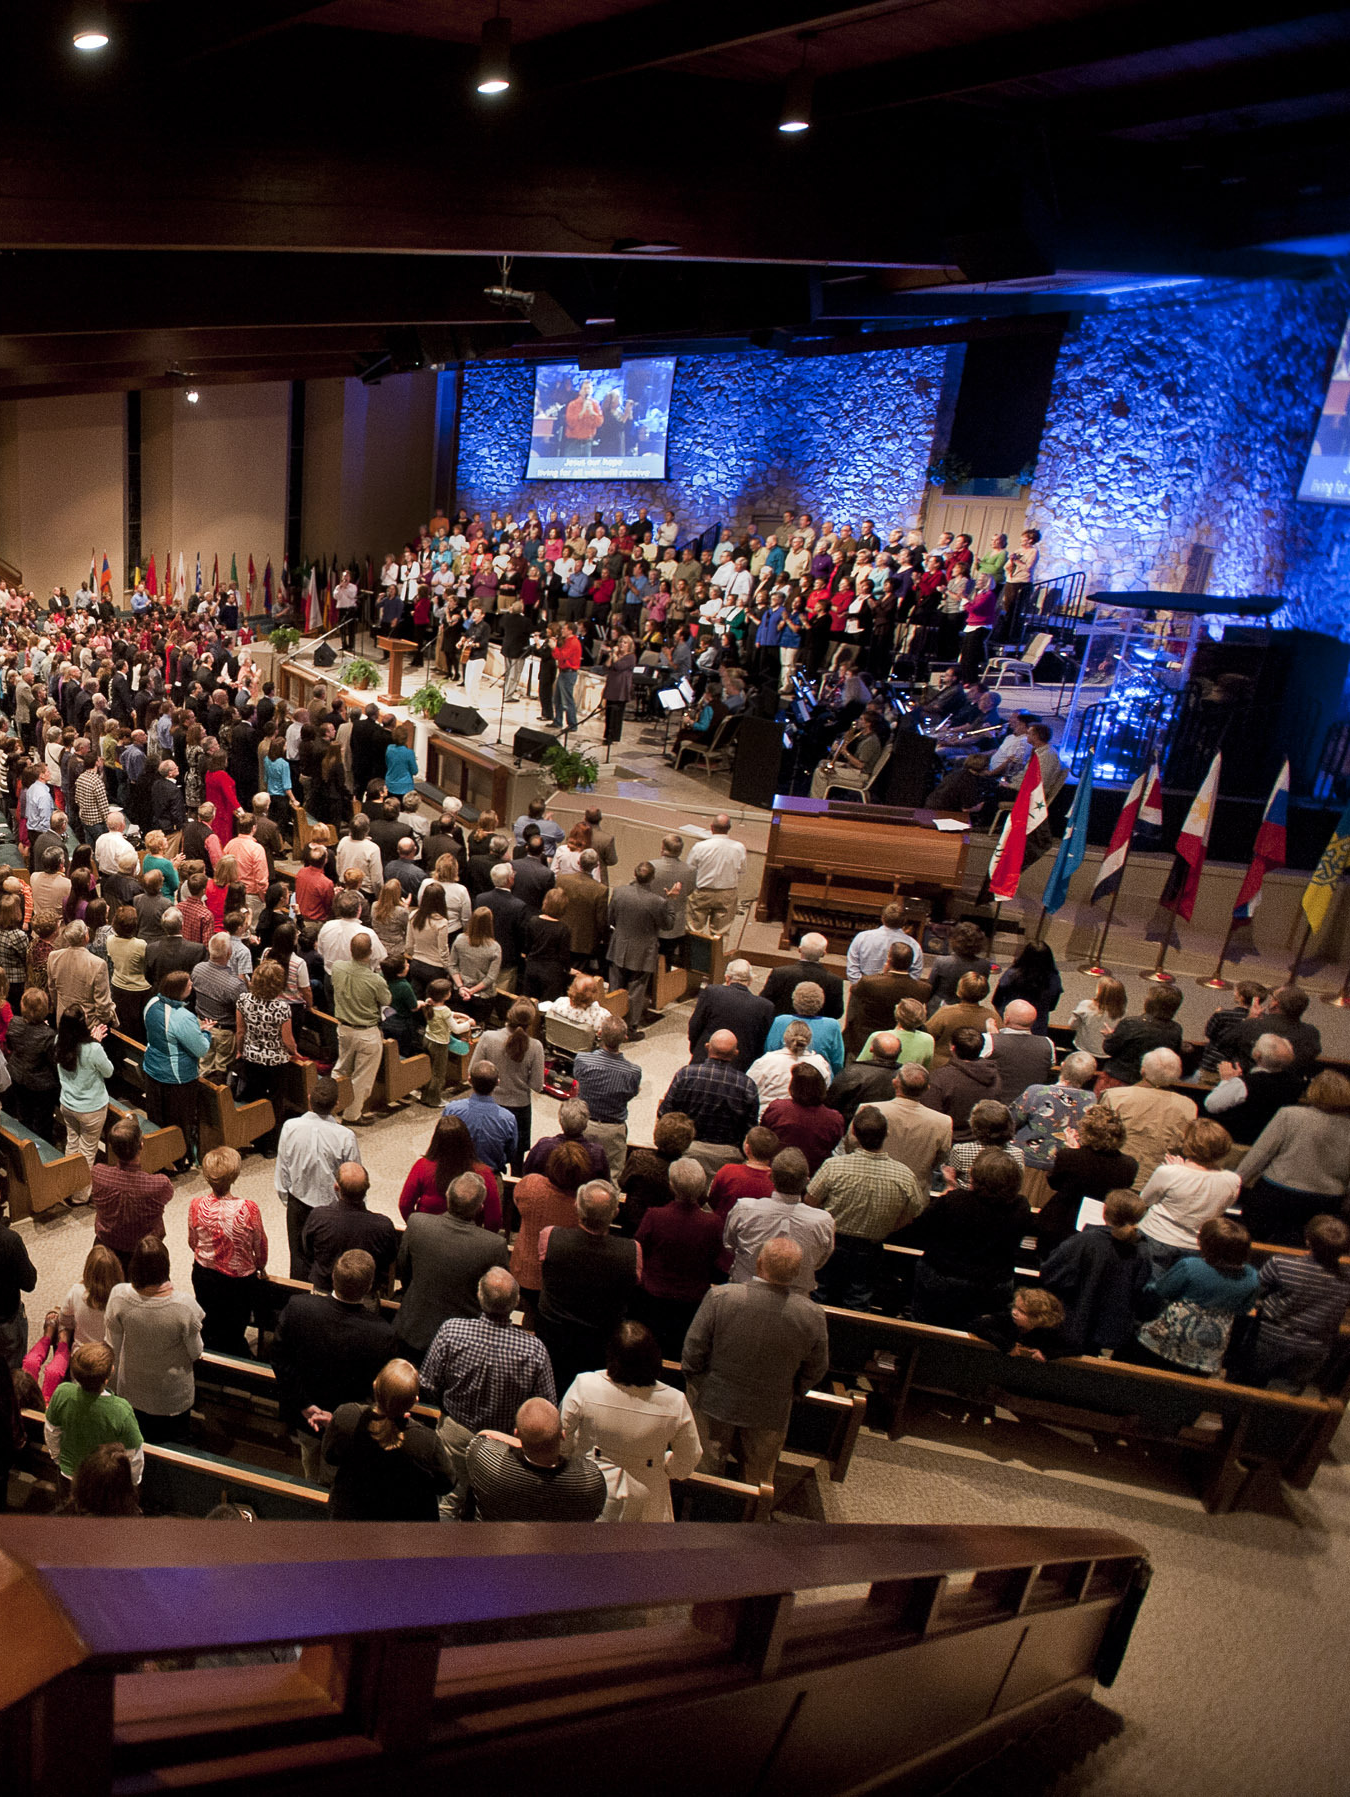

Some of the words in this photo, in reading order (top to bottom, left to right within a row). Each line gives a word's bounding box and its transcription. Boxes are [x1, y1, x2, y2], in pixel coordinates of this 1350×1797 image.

[587, 459, 601, 467] our
[602, 458, 623, 468] hope
[560, 468, 571, 477] for
[572, 468, 584, 477] all
[619, 469, 650, 477] receive
